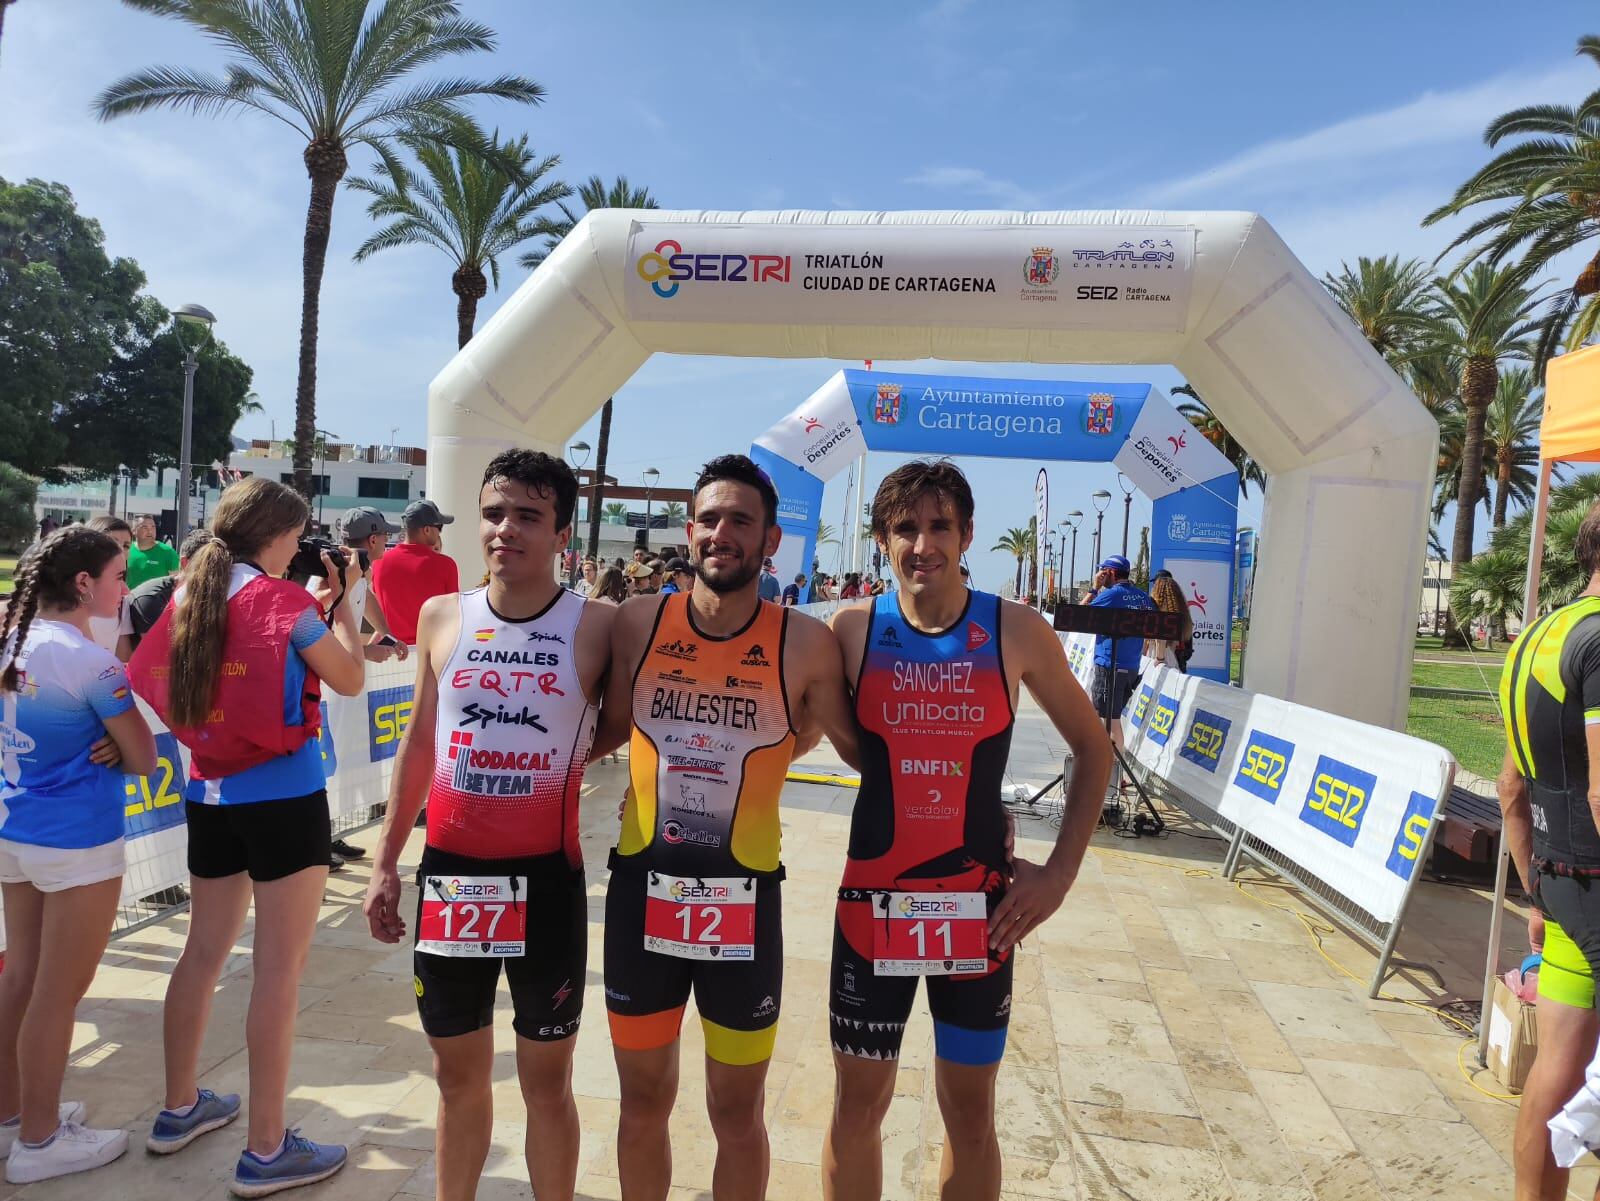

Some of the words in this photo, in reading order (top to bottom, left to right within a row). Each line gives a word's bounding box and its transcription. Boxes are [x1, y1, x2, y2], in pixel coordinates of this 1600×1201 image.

[804, 251, 884, 269] TRIATLÓN
[1072, 250, 1175, 262] TRIATLON
[803, 276, 864, 291] CIUDAD
[868, 277, 890, 291] DE
[895, 277, 996, 293] CARTAGENA
[1076, 286, 1118, 300] SER
[1125, 294, 1171, 302] CARTAGENA
[919, 386, 1065, 408] Ayuntamiento
[917, 405, 1062, 438] Cartagena
[807, 426, 851, 463] Deportes
[1135, 440, 1177, 483] Deportes
[467, 649, 559, 667] CANALES
[892, 661, 975, 693] SANCHEZ
[374, 701, 414, 745] SE
[651, 687, 757, 731] BALLESTER
[901, 759, 963, 776] BNFIX
[1240, 744, 1286, 790] SER
[1308, 773, 1366, 829] SER
[438, 903, 506, 939] 127
[675, 905, 723, 942] 12
[908, 921, 952, 957] 11
